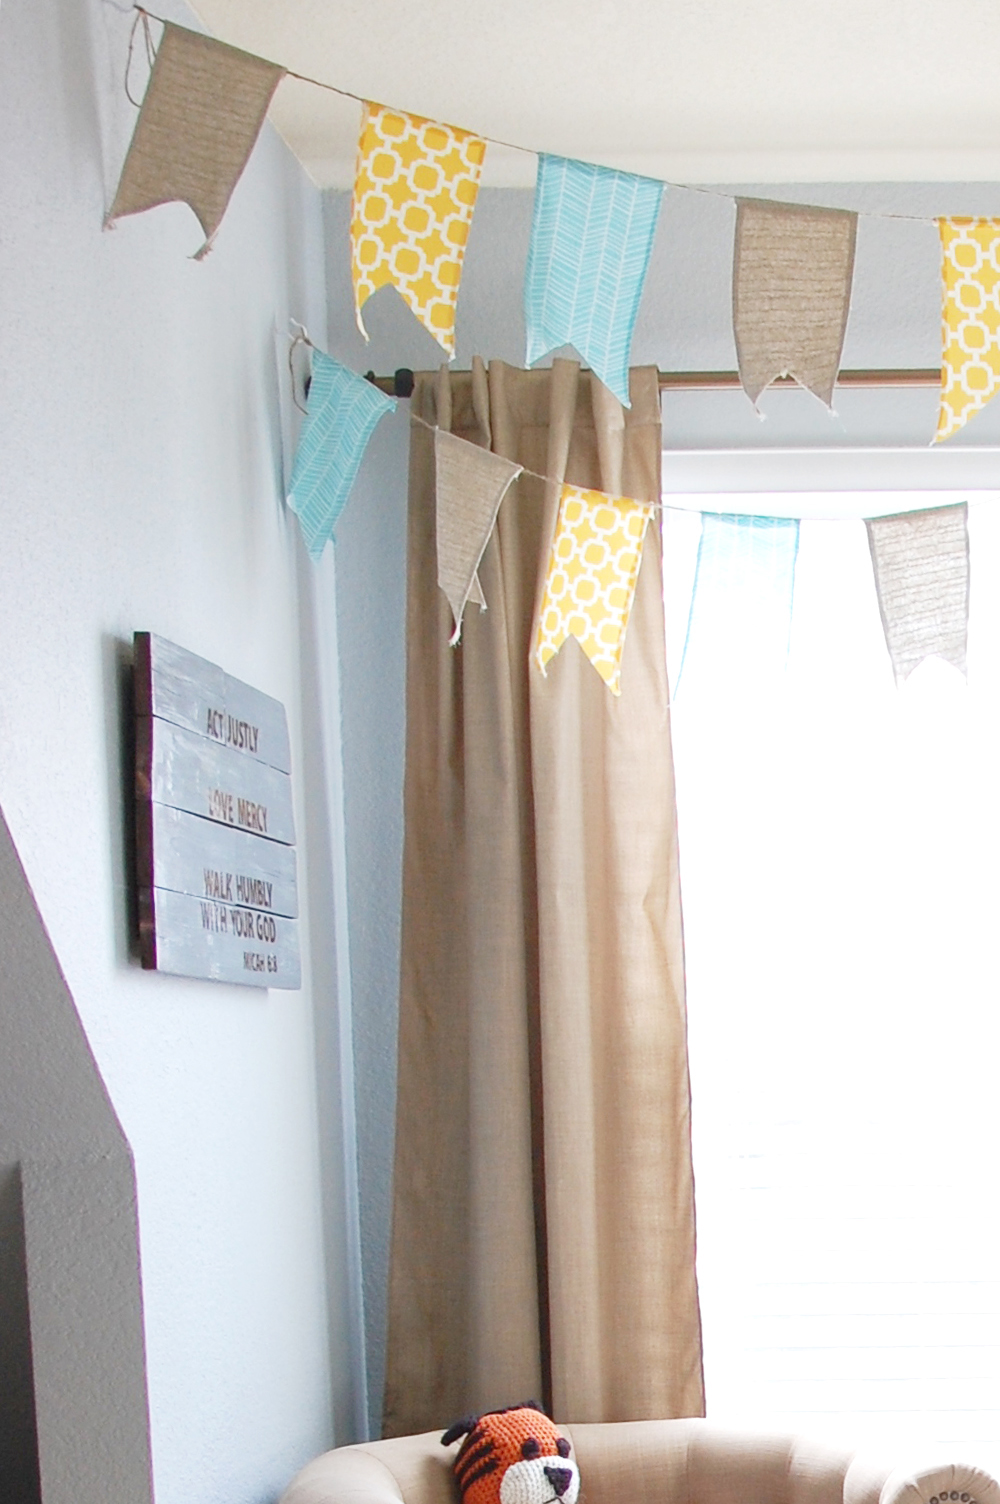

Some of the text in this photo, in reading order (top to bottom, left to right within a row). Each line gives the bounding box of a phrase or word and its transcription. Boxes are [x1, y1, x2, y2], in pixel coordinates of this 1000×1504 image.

[207, 708, 259, 753] ACT JUSTLY
[208, 787, 268, 833] LOVE MERCY
[203, 867, 273, 908] WALK HUMBLY
[200, 901, 277, 943] WITH YOUR GOD
[243, 951, 266, 973] MICAH
